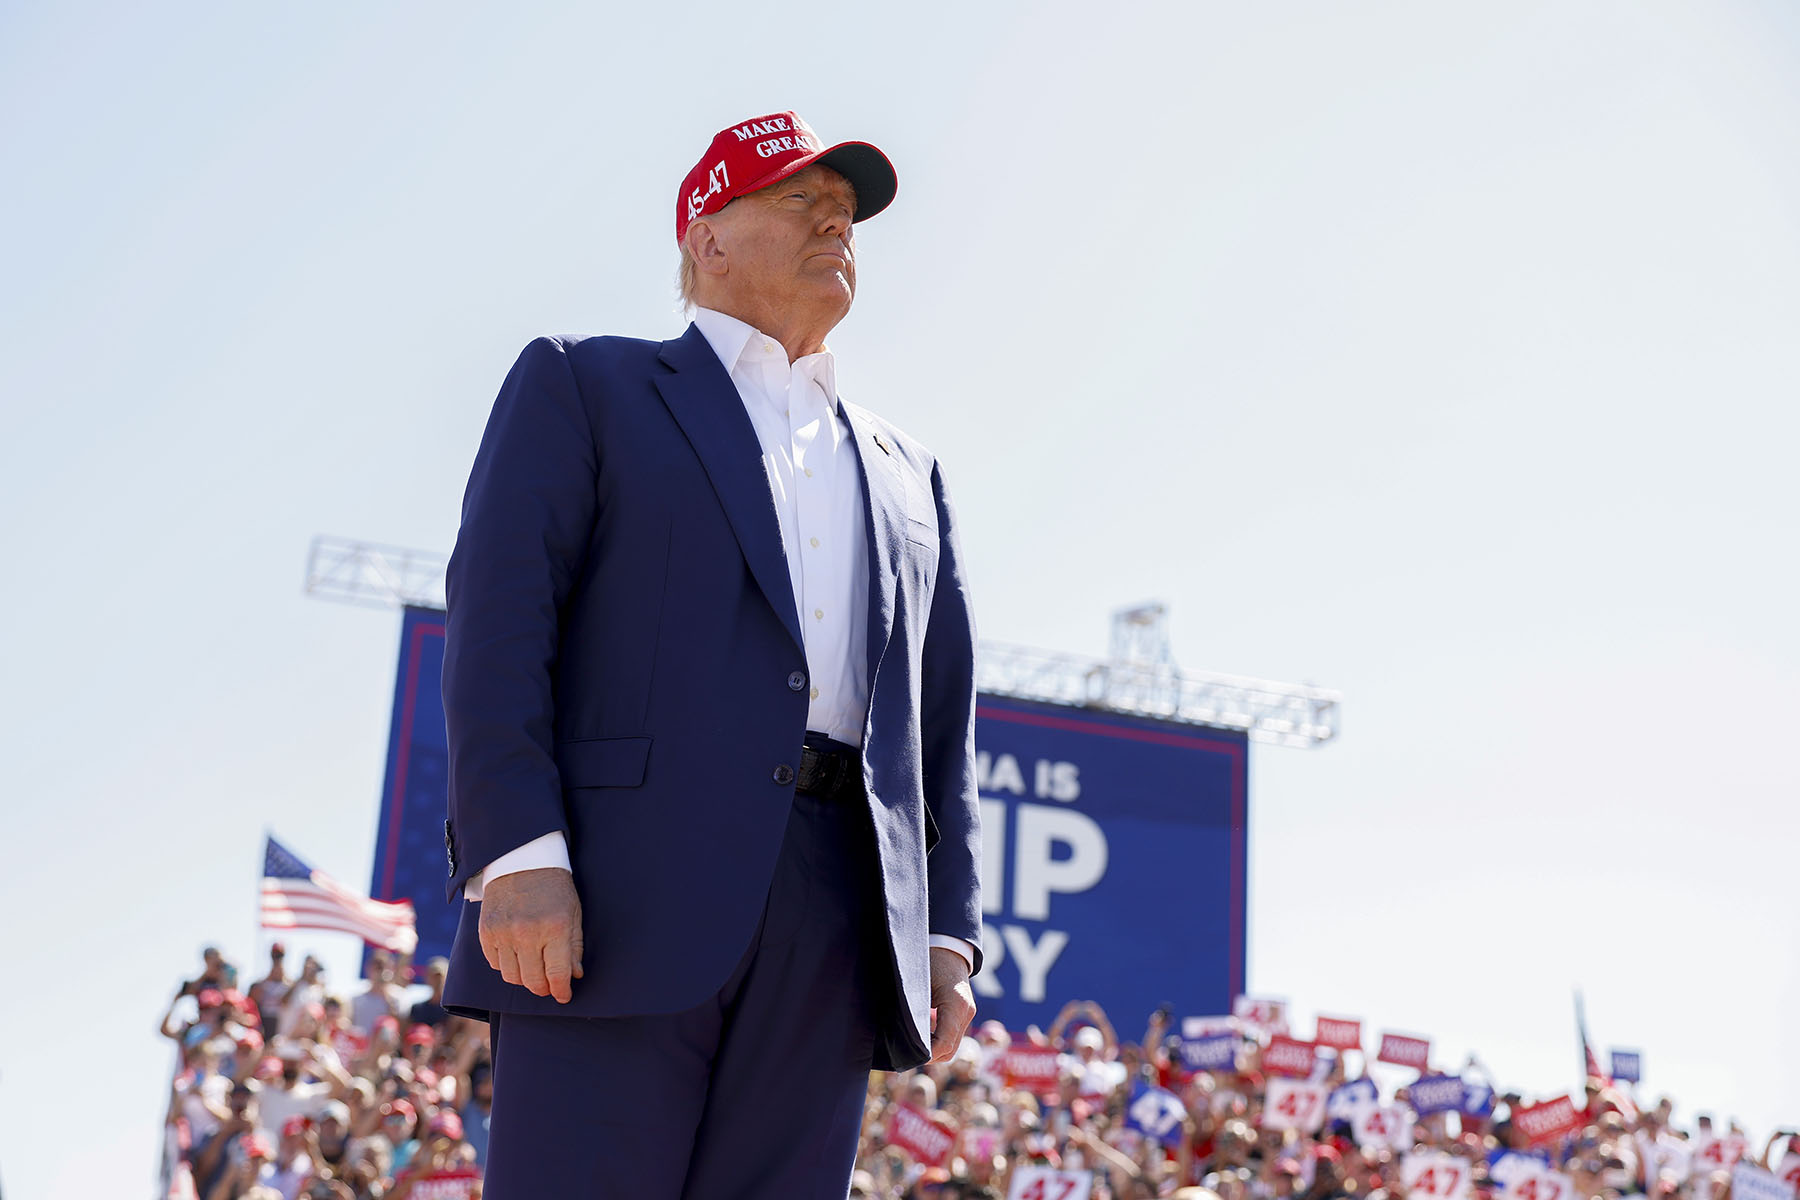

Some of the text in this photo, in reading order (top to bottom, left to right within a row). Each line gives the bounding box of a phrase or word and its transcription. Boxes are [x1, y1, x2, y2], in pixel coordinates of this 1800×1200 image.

[732, 118, 790, 142] MAKE
[688, 160, 730, 221] 45-47
[1034, 758, 1081, 802] IS
[1276, 1090, 1317, 1118] 47
[1022, 1176, 1076, 1200] 47
[1415, 1168, 1459, 1196] 47
[1516, 1177, 1560, 1200] 47
